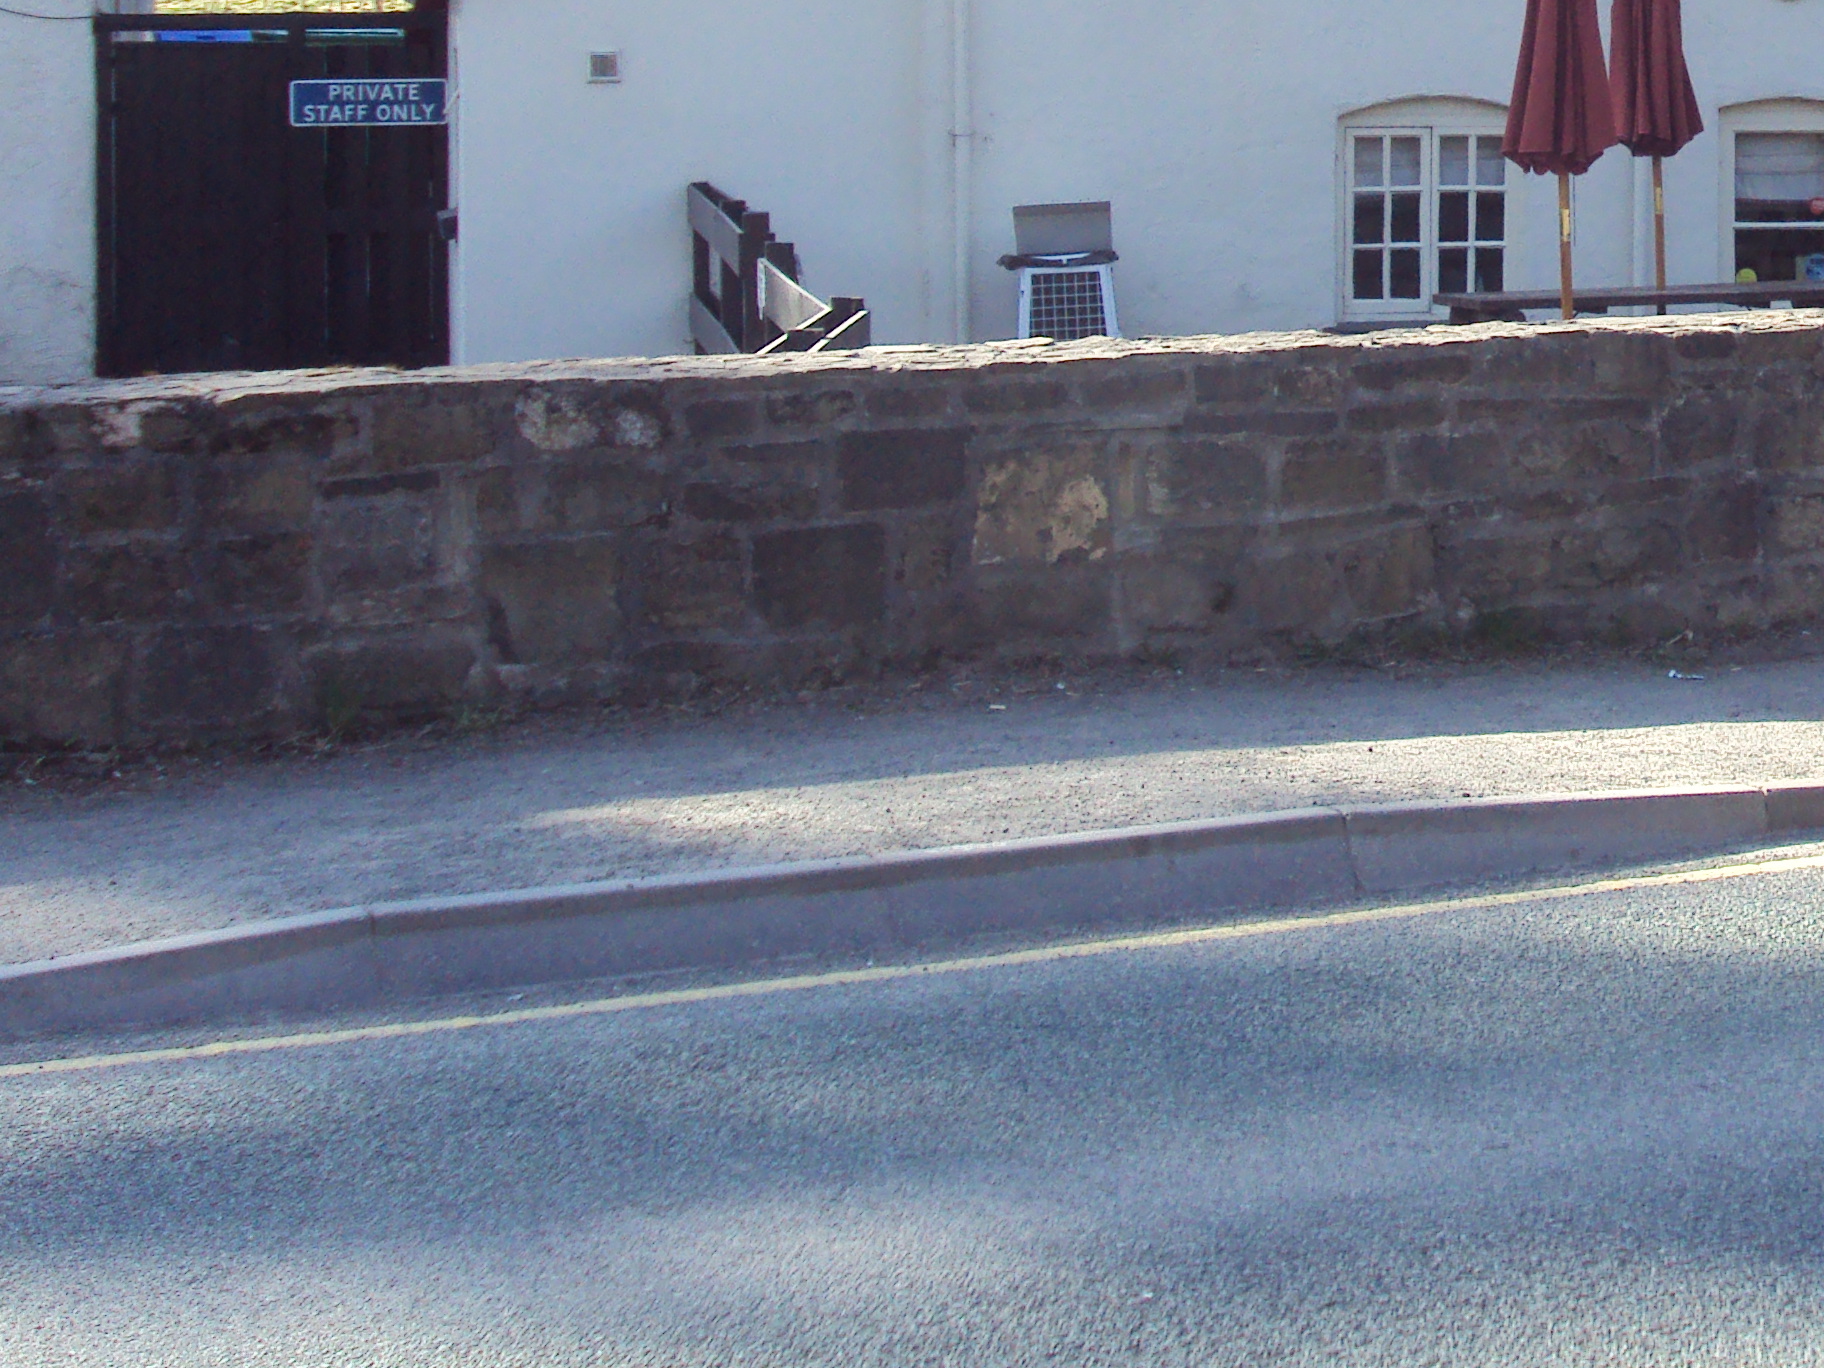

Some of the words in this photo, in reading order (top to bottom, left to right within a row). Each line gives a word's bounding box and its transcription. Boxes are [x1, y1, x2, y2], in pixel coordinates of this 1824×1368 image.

[329, 85, 420, 101] PRIVATE
[304, 105, 368, 122] STAFF
[376, 104, 434, 121] ONLY
